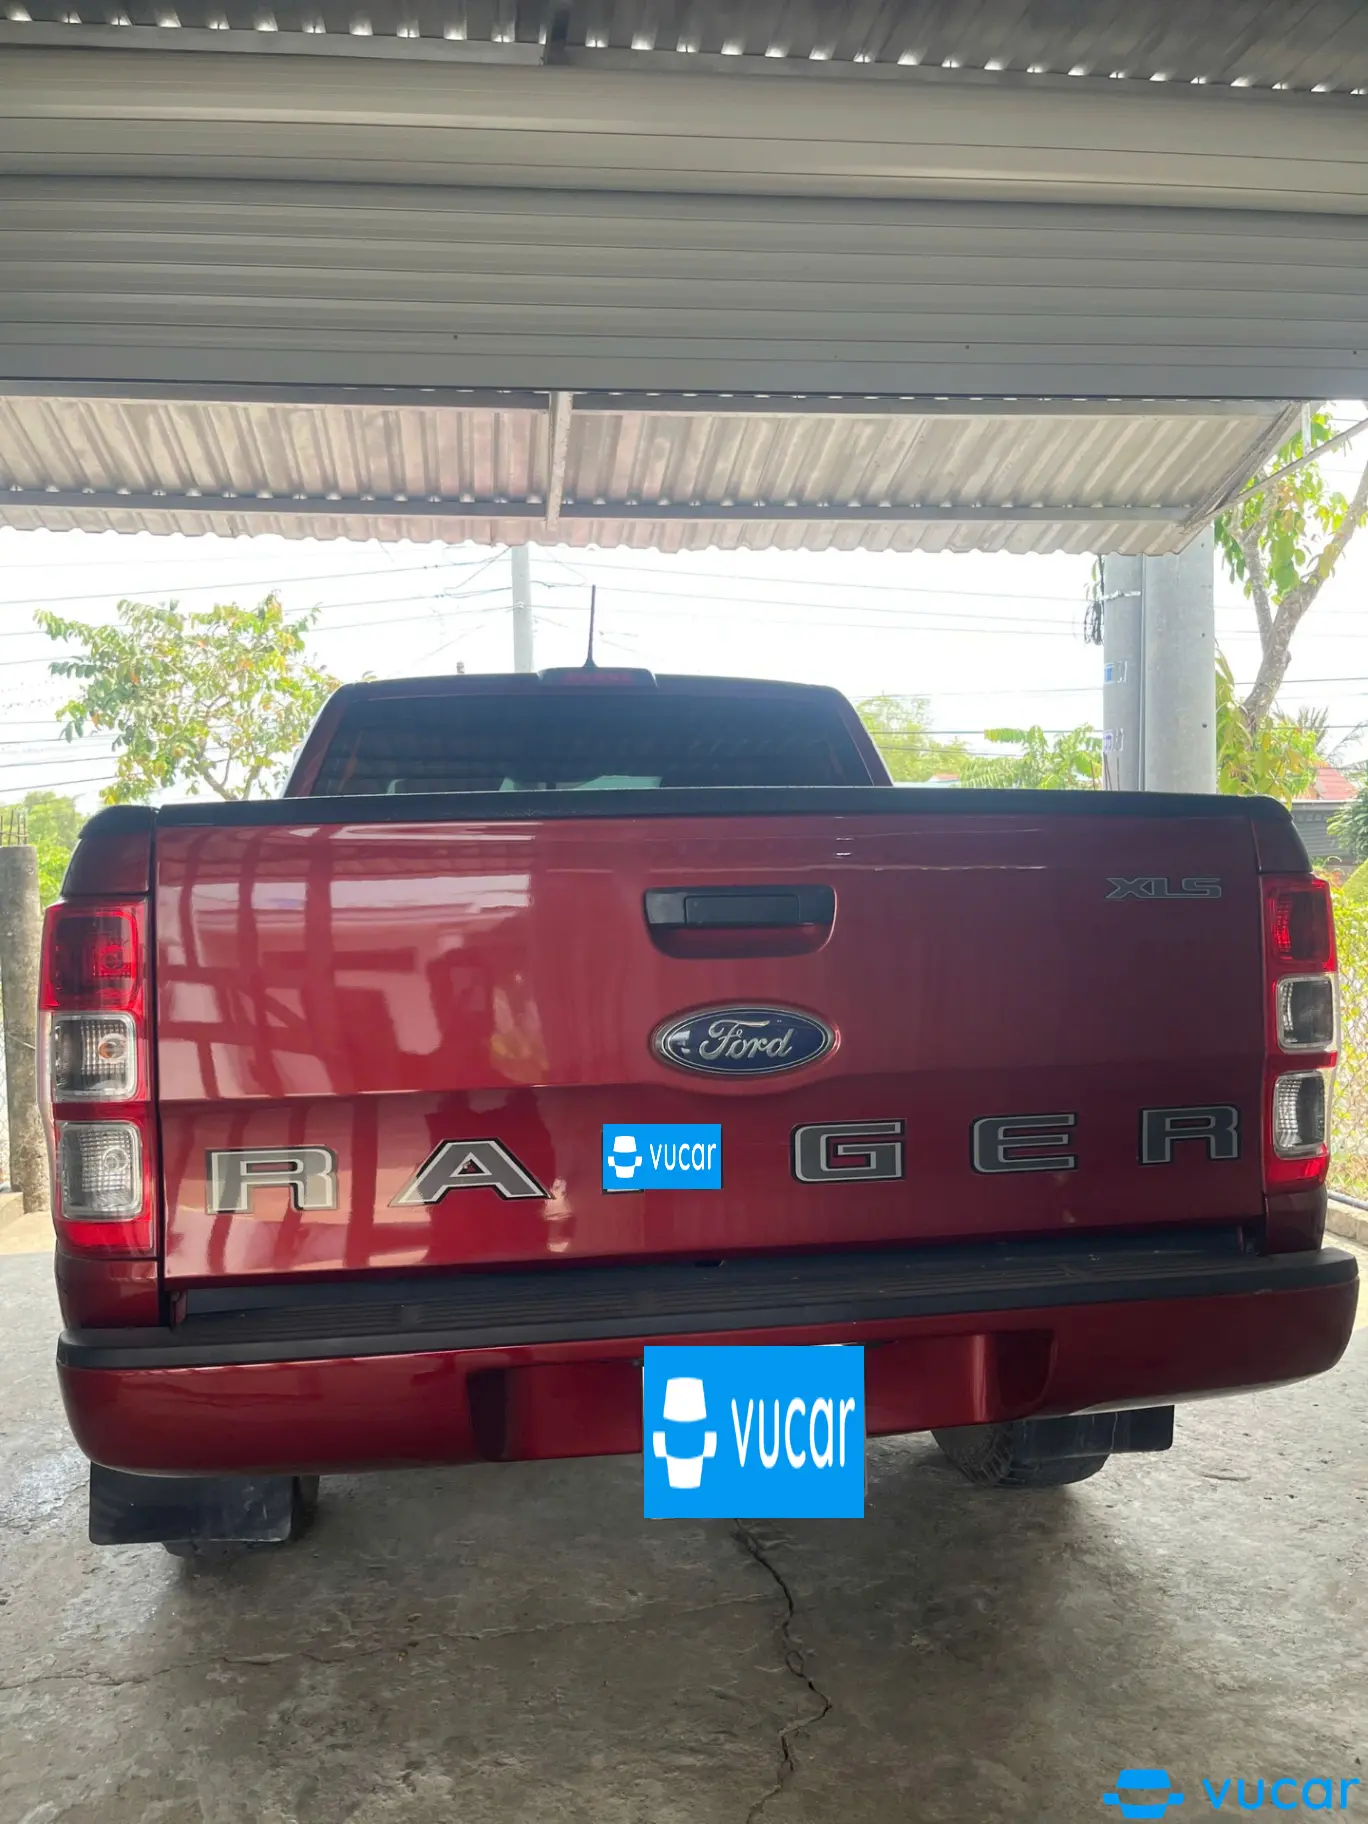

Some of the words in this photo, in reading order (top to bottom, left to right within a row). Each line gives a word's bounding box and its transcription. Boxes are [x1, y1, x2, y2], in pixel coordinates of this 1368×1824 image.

[1104, 877, 1222, 899] XLS
[699, 1019, 794, 1060] Ford
[205, 1105, 1241, 1215] RAGER
